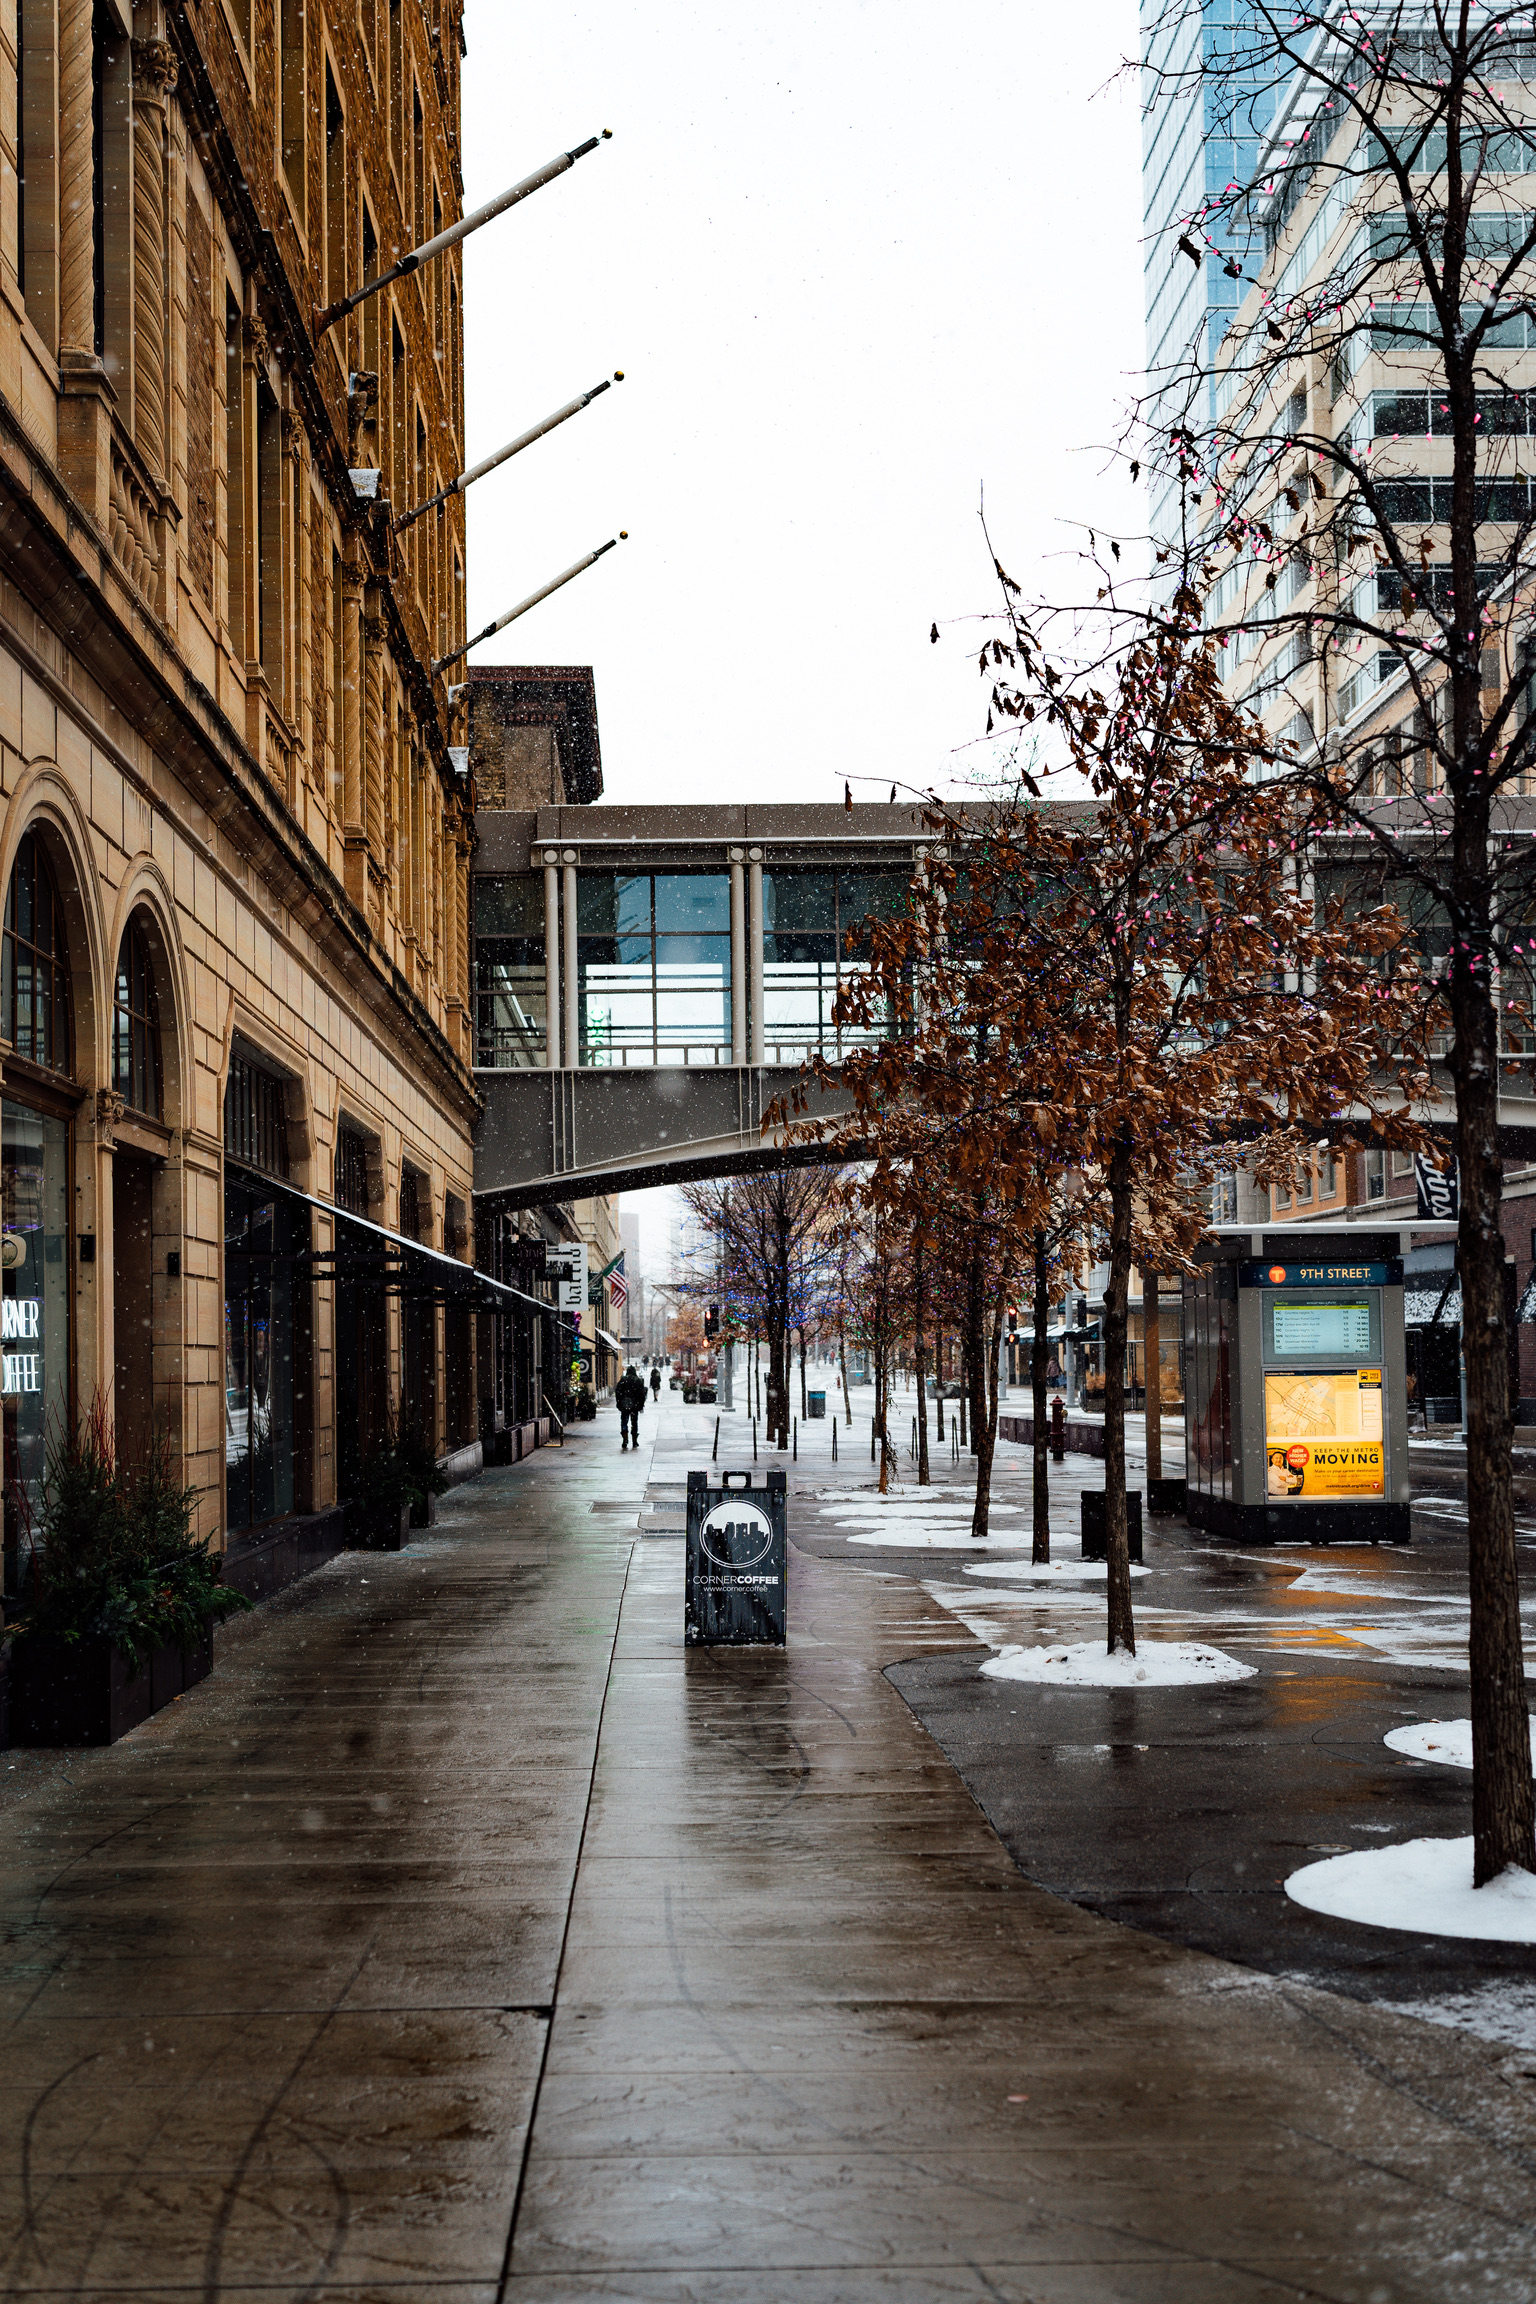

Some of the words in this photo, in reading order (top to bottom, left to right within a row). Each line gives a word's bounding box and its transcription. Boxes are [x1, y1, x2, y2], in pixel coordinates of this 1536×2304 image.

[1417, 1152, 1456, 1218] wins
[1300, 1268, 1324, 1279] 9TH
[1327, 1268, 1371, 1279] STREET
[2, 1299, 39, 1338] ORNER
[2, 1354, 40, 1392] OFFEE
[1315, 1454, 1379, 1465] MOVING
